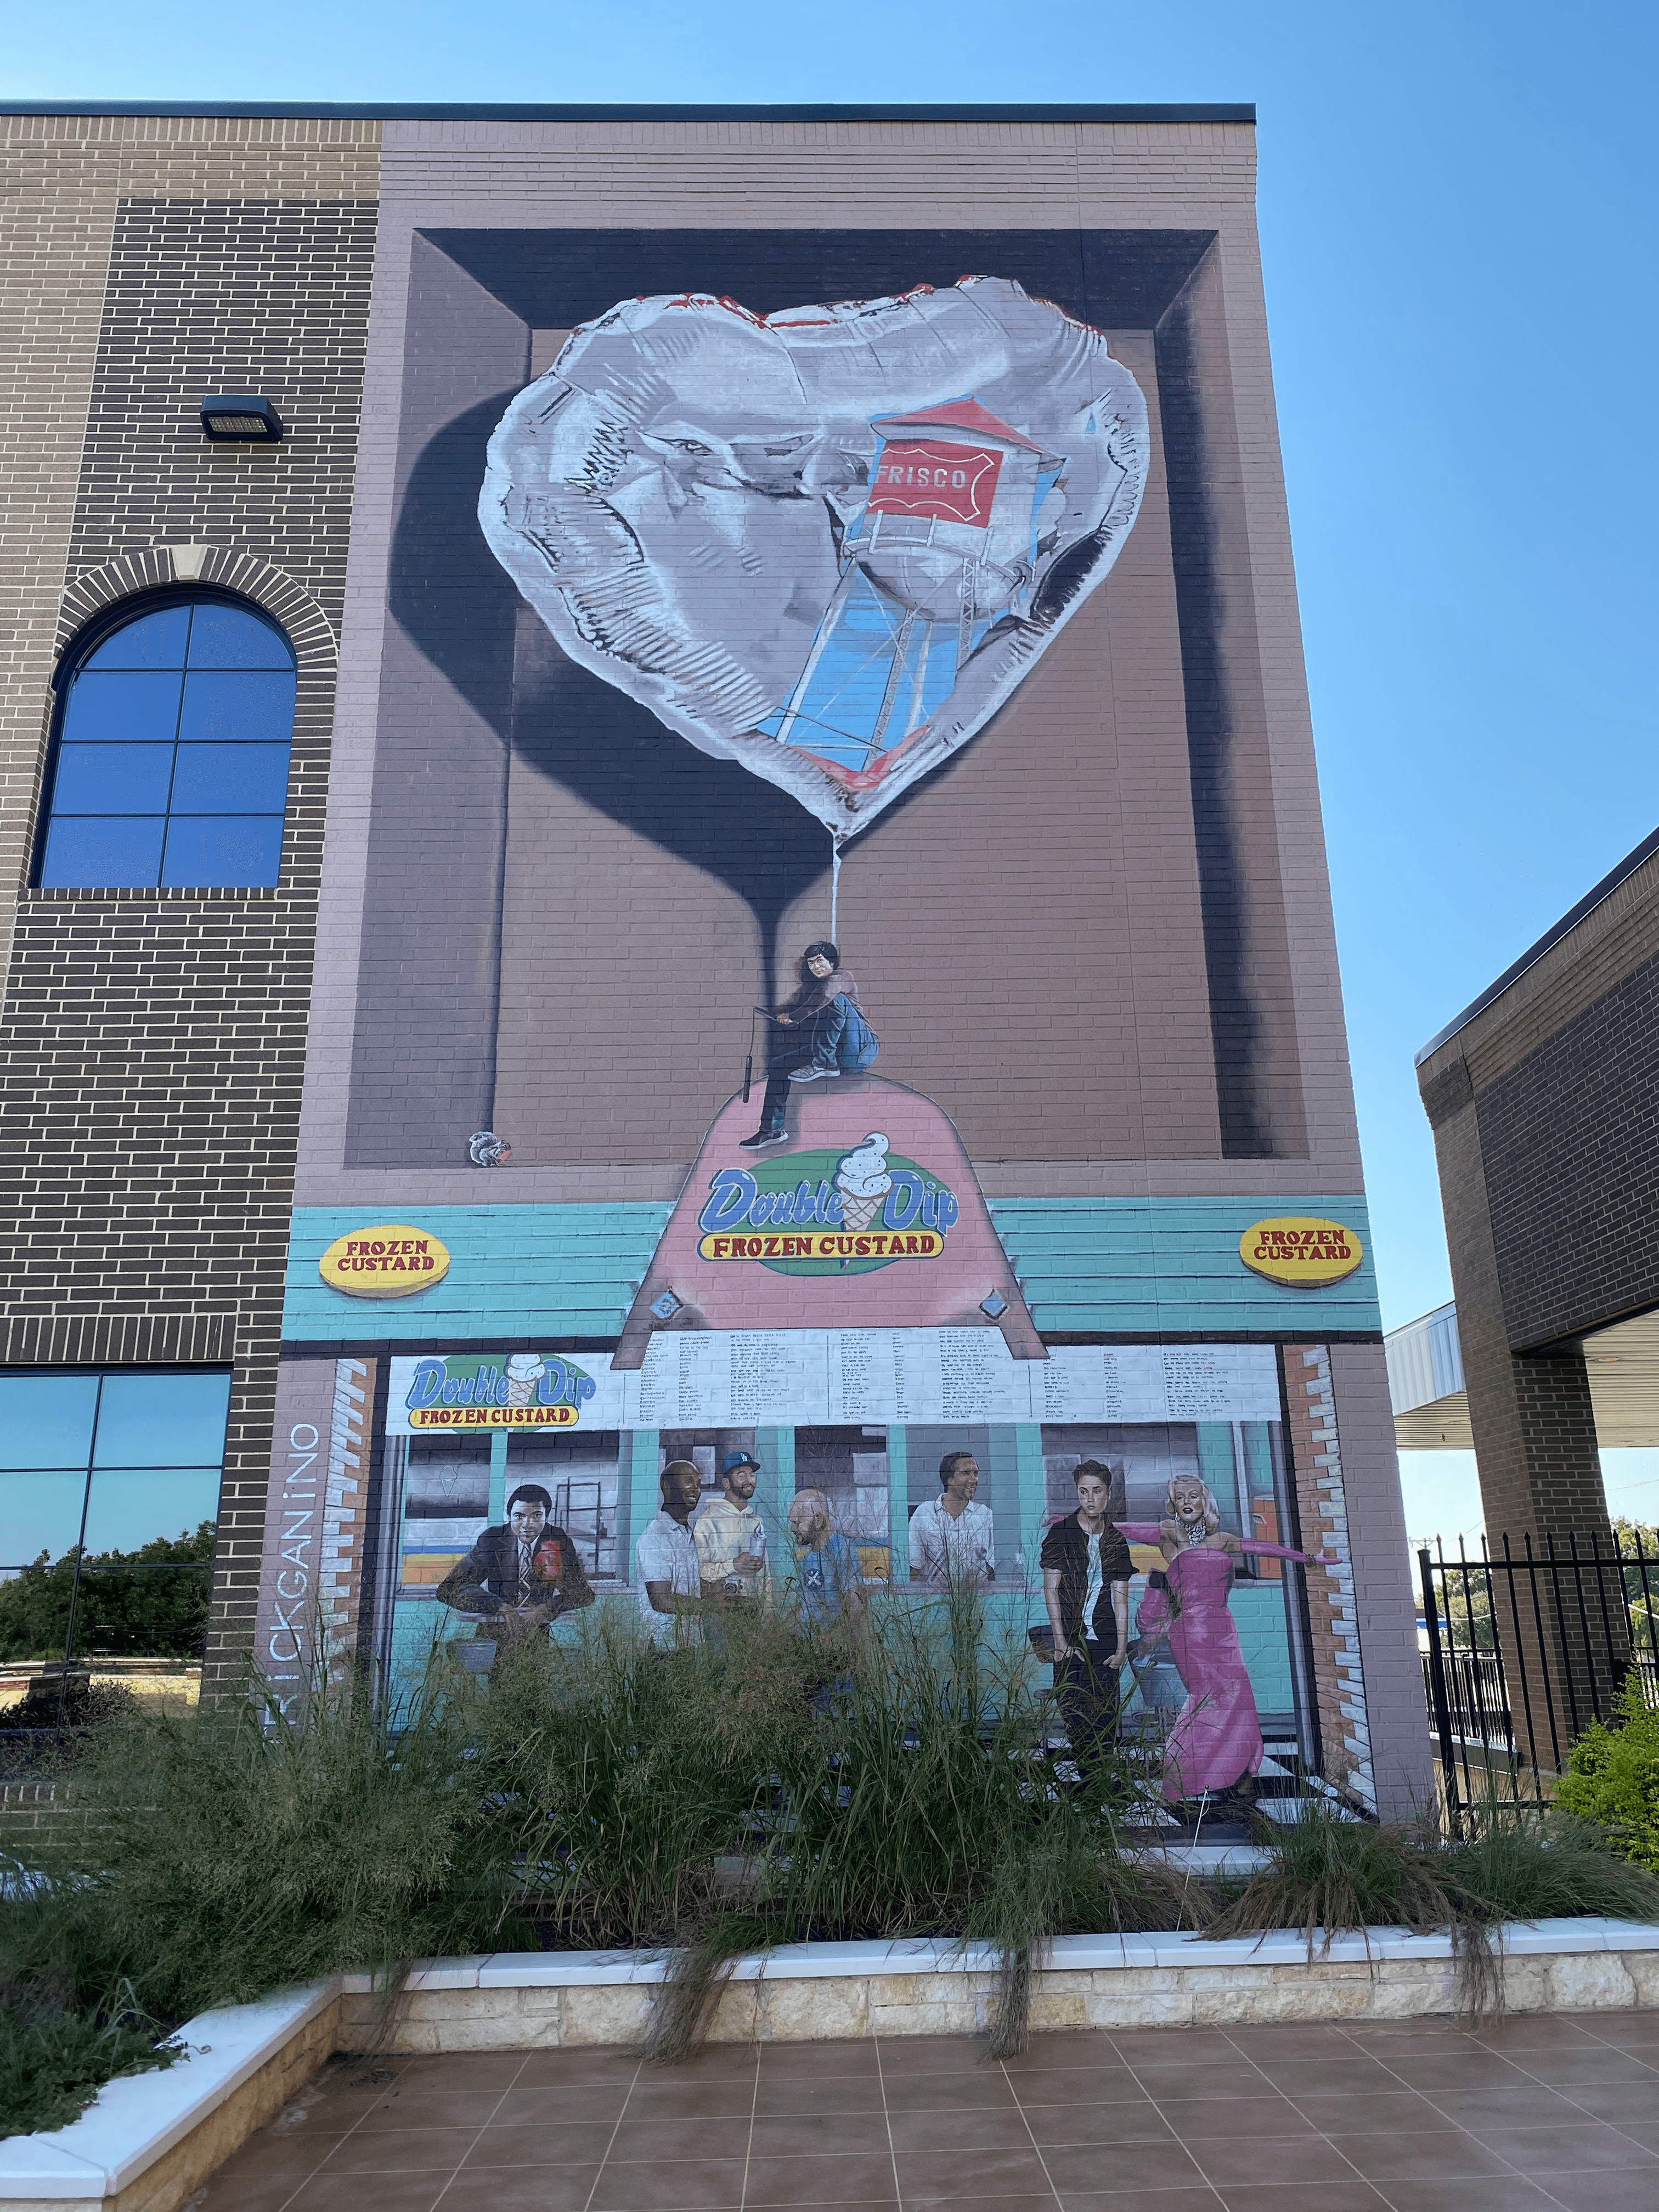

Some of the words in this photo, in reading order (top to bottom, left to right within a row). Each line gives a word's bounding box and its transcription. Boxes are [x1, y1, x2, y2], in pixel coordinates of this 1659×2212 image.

[876, 465, 966, 489] FRISCO
[698, 1167, 844, 1233] Double
[883, 1169, 959, 1237] Dip
[1259, 1229, 1345, 1245] FROZEN
[346, 1240, 428, 1256] FROZEN
[713, 1237, 813, 1257] FROZEN
[820, 1235, 935, 1256] CUSTARD
[1254, 1245, 1351, 1260] CUSTARD
[337, 1256, 435, 1271] CUSTARD
[405, 1359, 510, 1409] Double
[536, 1359, 597, 1410] Dip
[420, 1408, 488, 1424] FROZEN
[491, 1408, 570, 1423] CUSTARD
